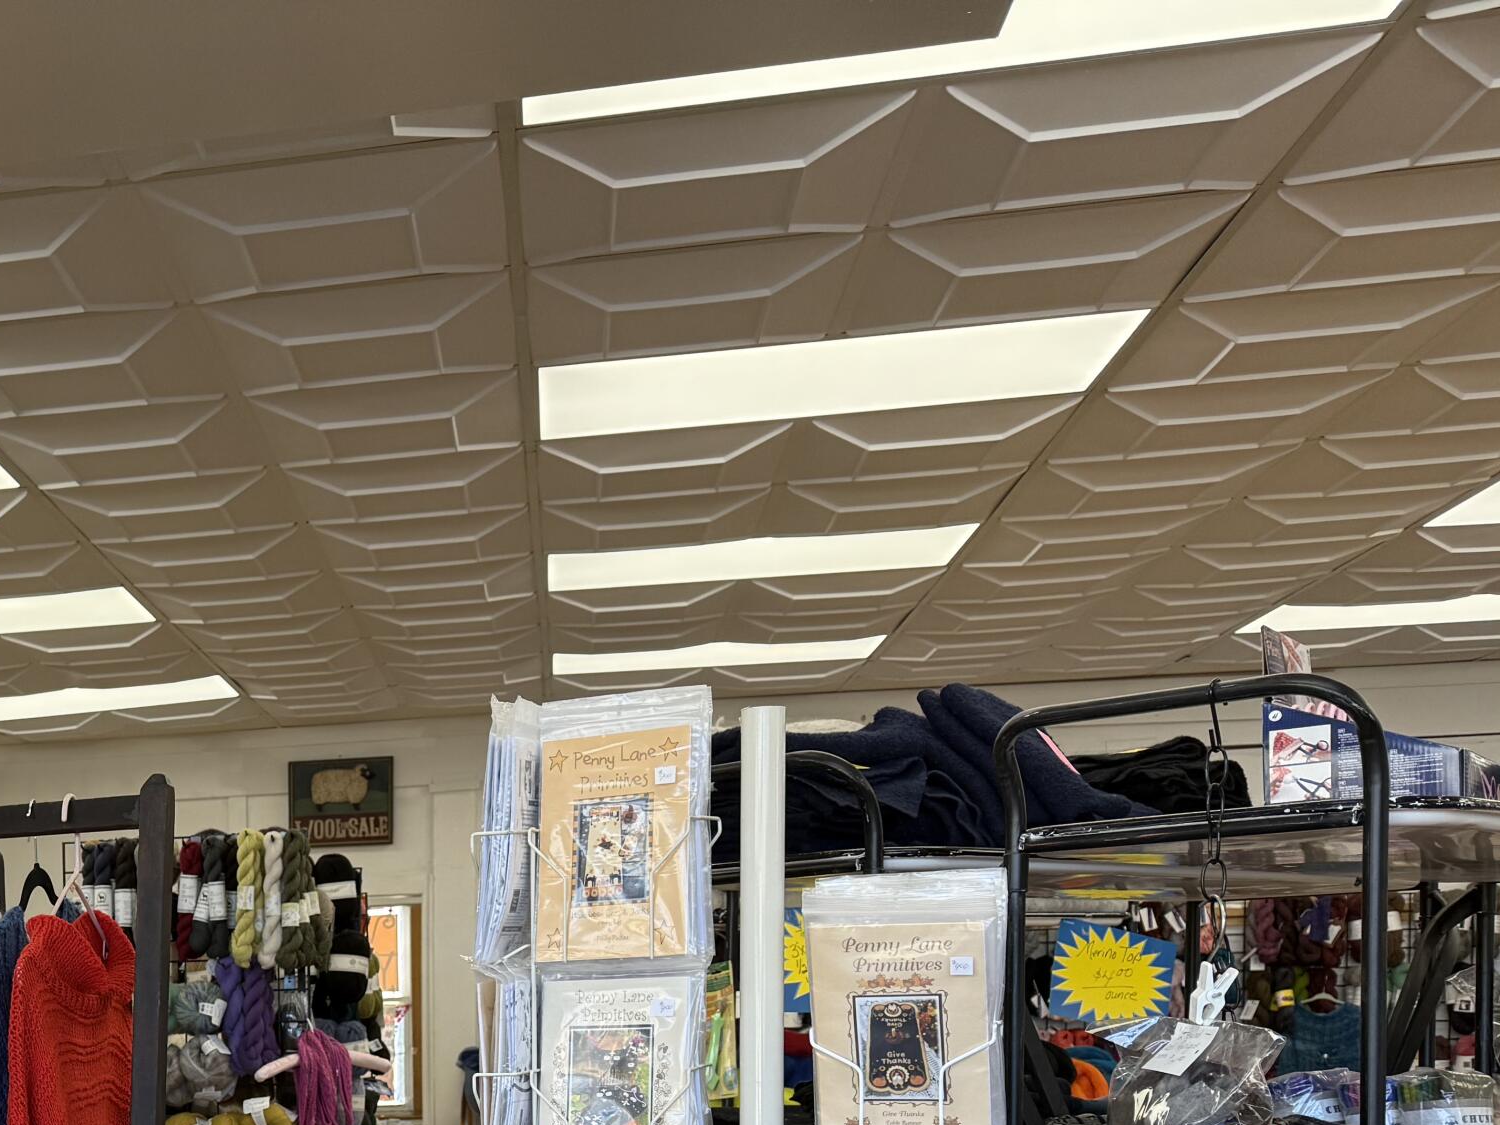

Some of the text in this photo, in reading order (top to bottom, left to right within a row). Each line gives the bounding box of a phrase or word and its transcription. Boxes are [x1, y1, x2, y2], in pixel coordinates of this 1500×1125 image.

[573, 745, 656, 770] Penny Lane
[580, 772, 649, 795] Primitives
[348, 815, 389, 838] SALE
[842, 936, 953, 957] Penny Lane
[1077, 940, 1142, 964] Merino Top
[852, 957, 943, 974] Primitives
[575, 989, 654, 1005] Penny Lane
[1105, 991, 1138, 1001] ounce
[581, 1008, 648, 1022] Primitives
[886, 1050, 906, 1058] Give
